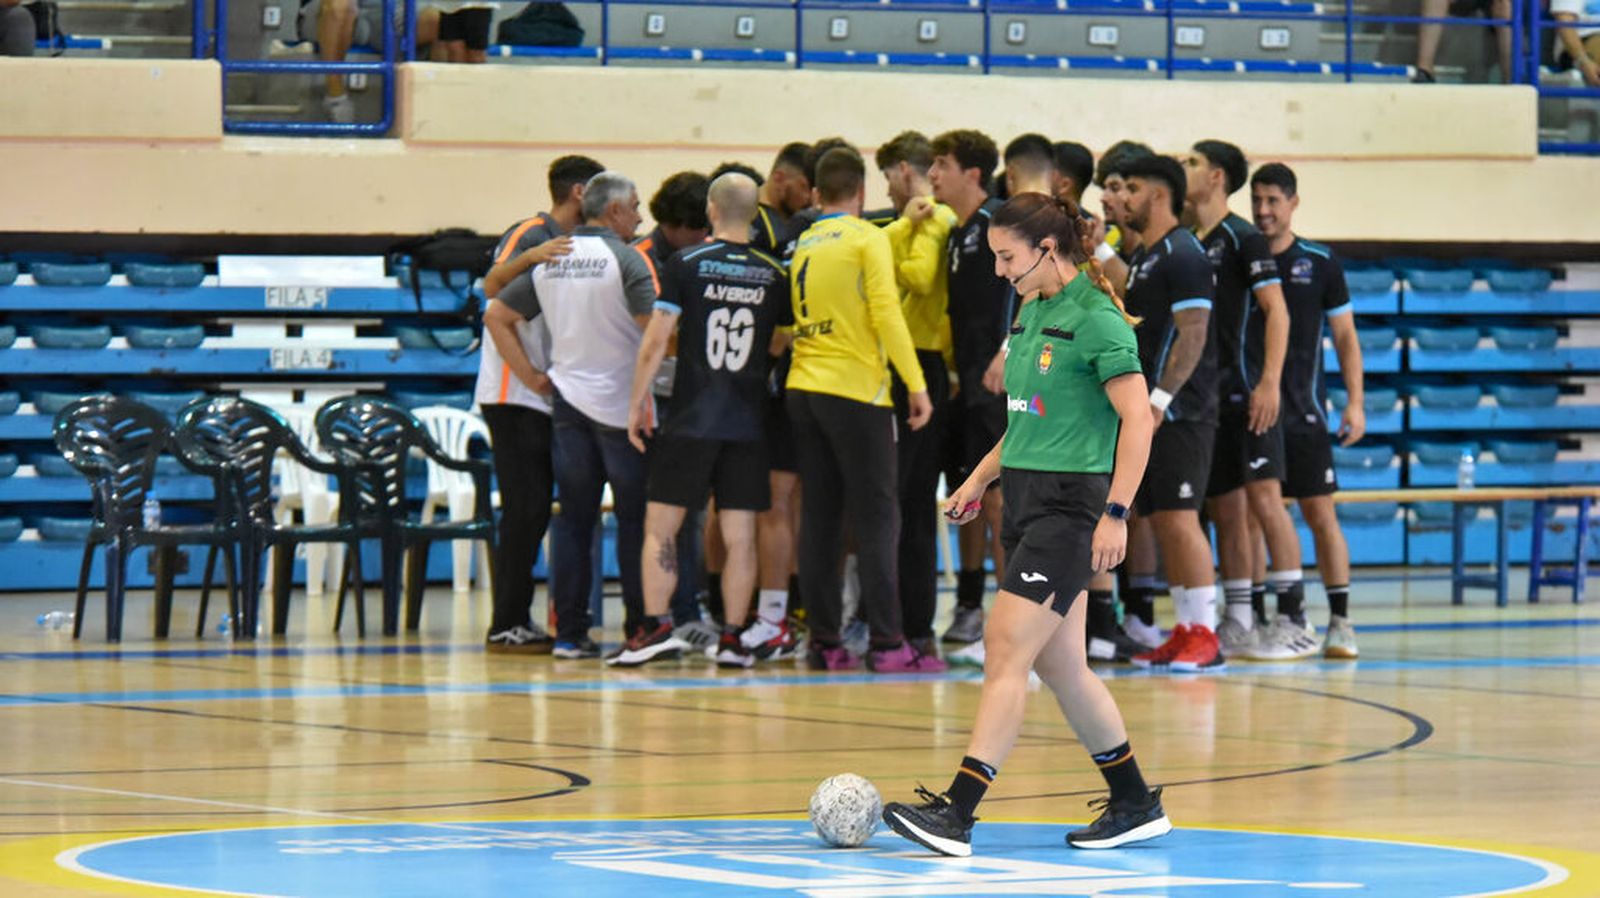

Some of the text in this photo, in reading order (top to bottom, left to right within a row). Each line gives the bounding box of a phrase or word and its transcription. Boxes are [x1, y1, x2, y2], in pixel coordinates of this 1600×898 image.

[267, 287, 308, 305] FILA
[706, 307, 754, 372] 69
[272, 349, 312, 367] FILA
